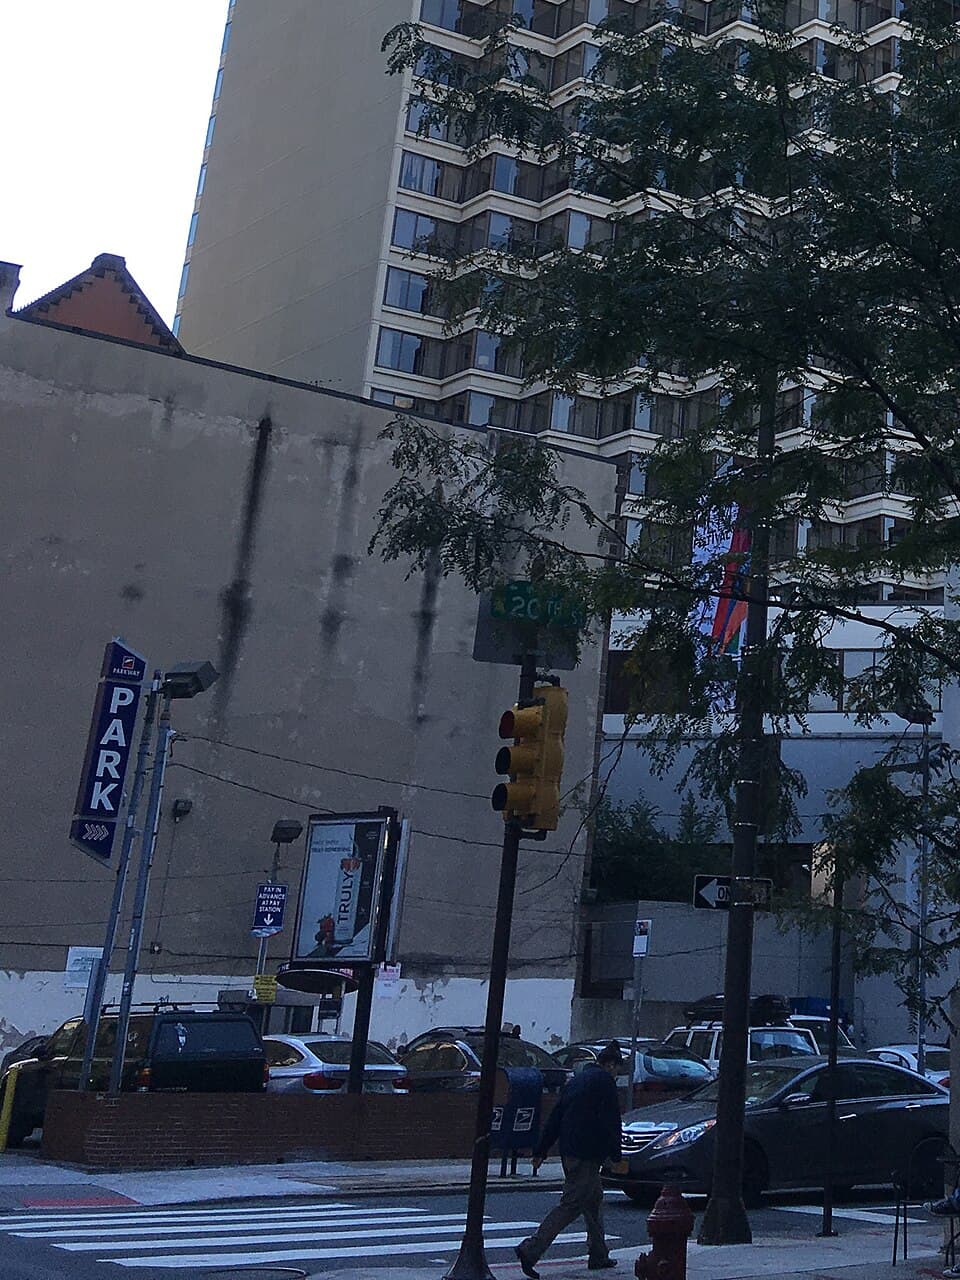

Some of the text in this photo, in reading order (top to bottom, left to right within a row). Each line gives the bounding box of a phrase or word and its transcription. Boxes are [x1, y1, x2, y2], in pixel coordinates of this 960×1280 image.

[112, 667, 140, 677] PARKWAY
[90, 686, 135, 811] PARK
[338, 871, 354, 924] TRULY
